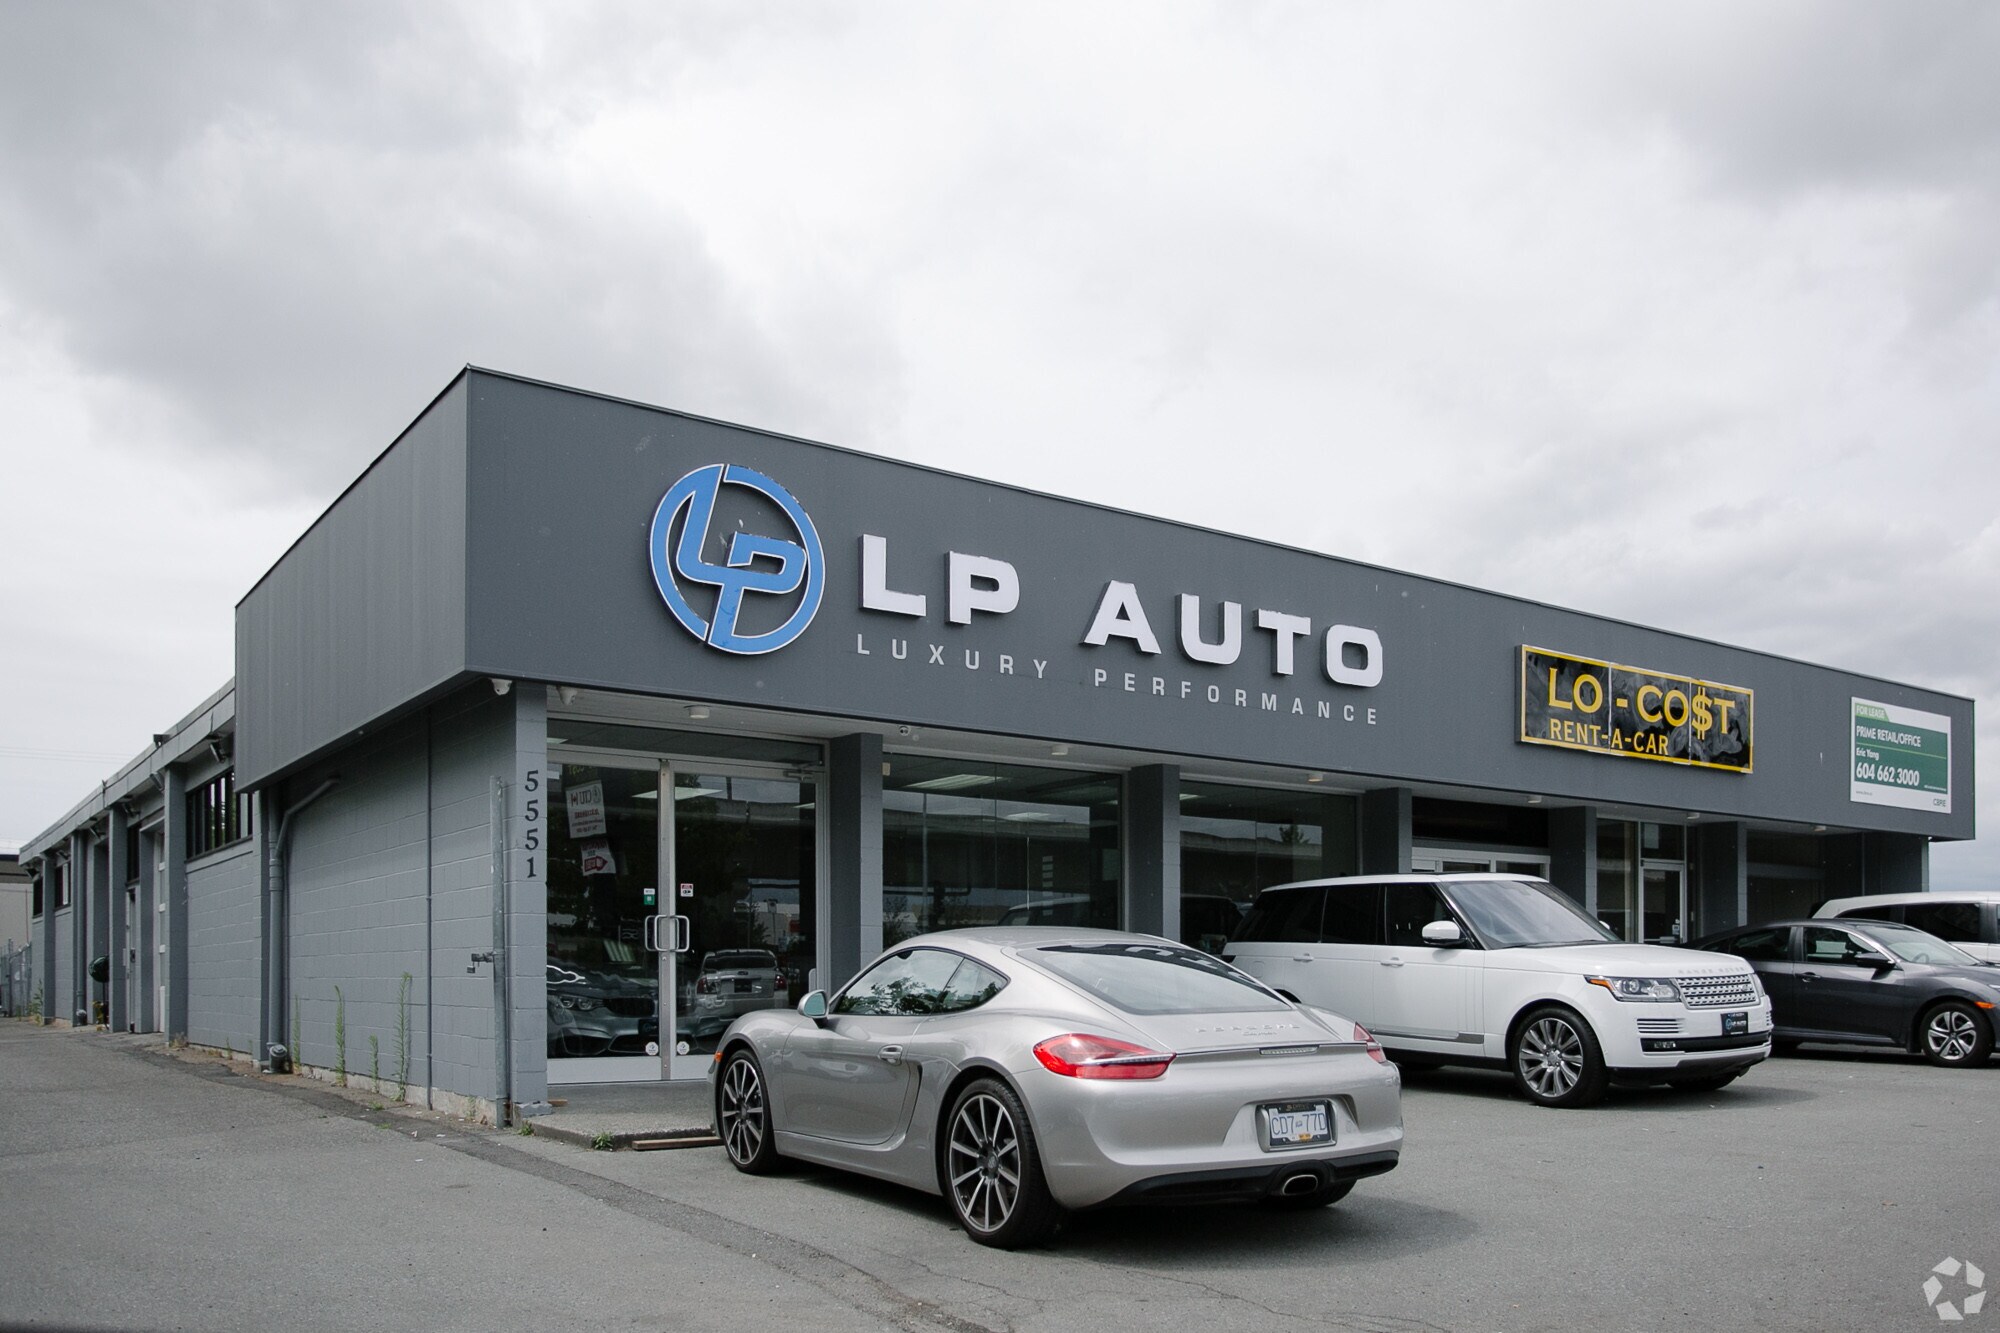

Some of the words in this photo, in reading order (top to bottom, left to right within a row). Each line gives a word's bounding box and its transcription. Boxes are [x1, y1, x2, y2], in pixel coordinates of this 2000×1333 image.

[860, 534, 1020, 625] LP
[1082, 580, 1384, 688] AUTO
[857, 633, 1048, 680] LUXURY
[1094, 668, 1378, 726] PERFORMANCE
[1856, 704, 1868, 716] FOR
[1869, 706, 1885, 719] LEASE
[1550, 718, 1669, 756] RENT-A-CAR
[1856, 725, 1877, 739] PRIME
[1877, 728, 1922, 747] RETAIL/OFFICE
[1856, 747, 1866, 757] Eric
[1856, 762, 1875, 780] 604
[1877, 765, 1895, 783] 662
[1896, 768, 1920, 787] 3000
[524, 769, 540, 878] 5551
